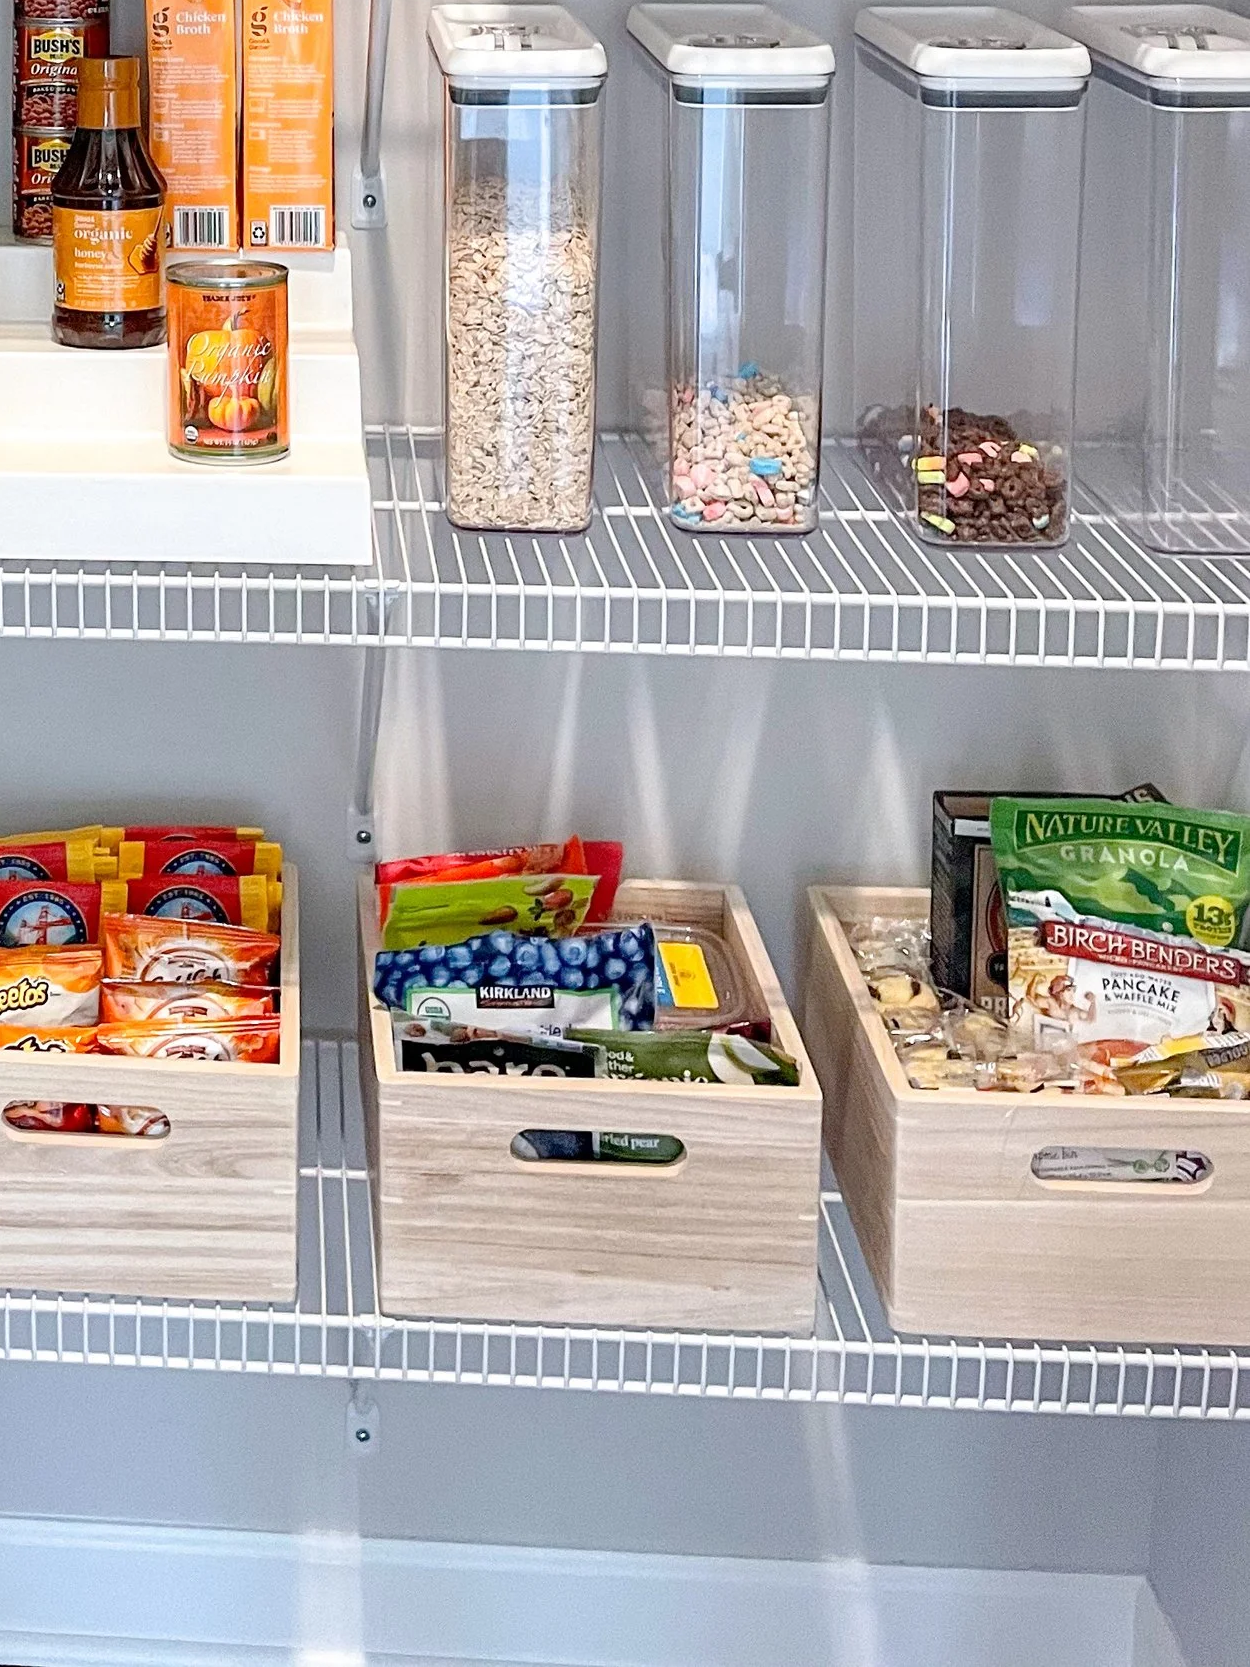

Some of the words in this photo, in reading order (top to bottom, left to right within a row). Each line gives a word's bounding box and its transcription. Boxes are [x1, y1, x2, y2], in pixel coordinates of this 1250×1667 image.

[175, 11, 227, 24] Chicken
[273, 10, 324, 22] Chicken
[175, 23, 211, 35] Broth
[273, 22, 309, 35] Broth
[33, 38, 82, 56] BUSH'S
[30, 62, 78, 77] Origina
[74, 227, 133, 246] organic
[74, 246, 108, 261] honey
[186, 333, 272, 363] Organic
[184, 354, 272, 409] Pumpkin
[1025, 812, 1130, 843] NATURE
[1133, 818, 1235, 864] VALLEY
[1060, 845, 1189, 872] GRANOLA
[1047, 924, 1128, 955] BIRCH
[1130, 940, 1237, 980] BENDERS
[479, 986, 551, 999] KIRKLAND
[1102, 977, 1181, 1004] PANCAKE
[1104, 994, 1111, 1002] &
[1115, 992, 1154, 1006] WAFFLE
[1156, 1000, 1177, 1014] MIX
[630, 1137, 660, 1150] pear
